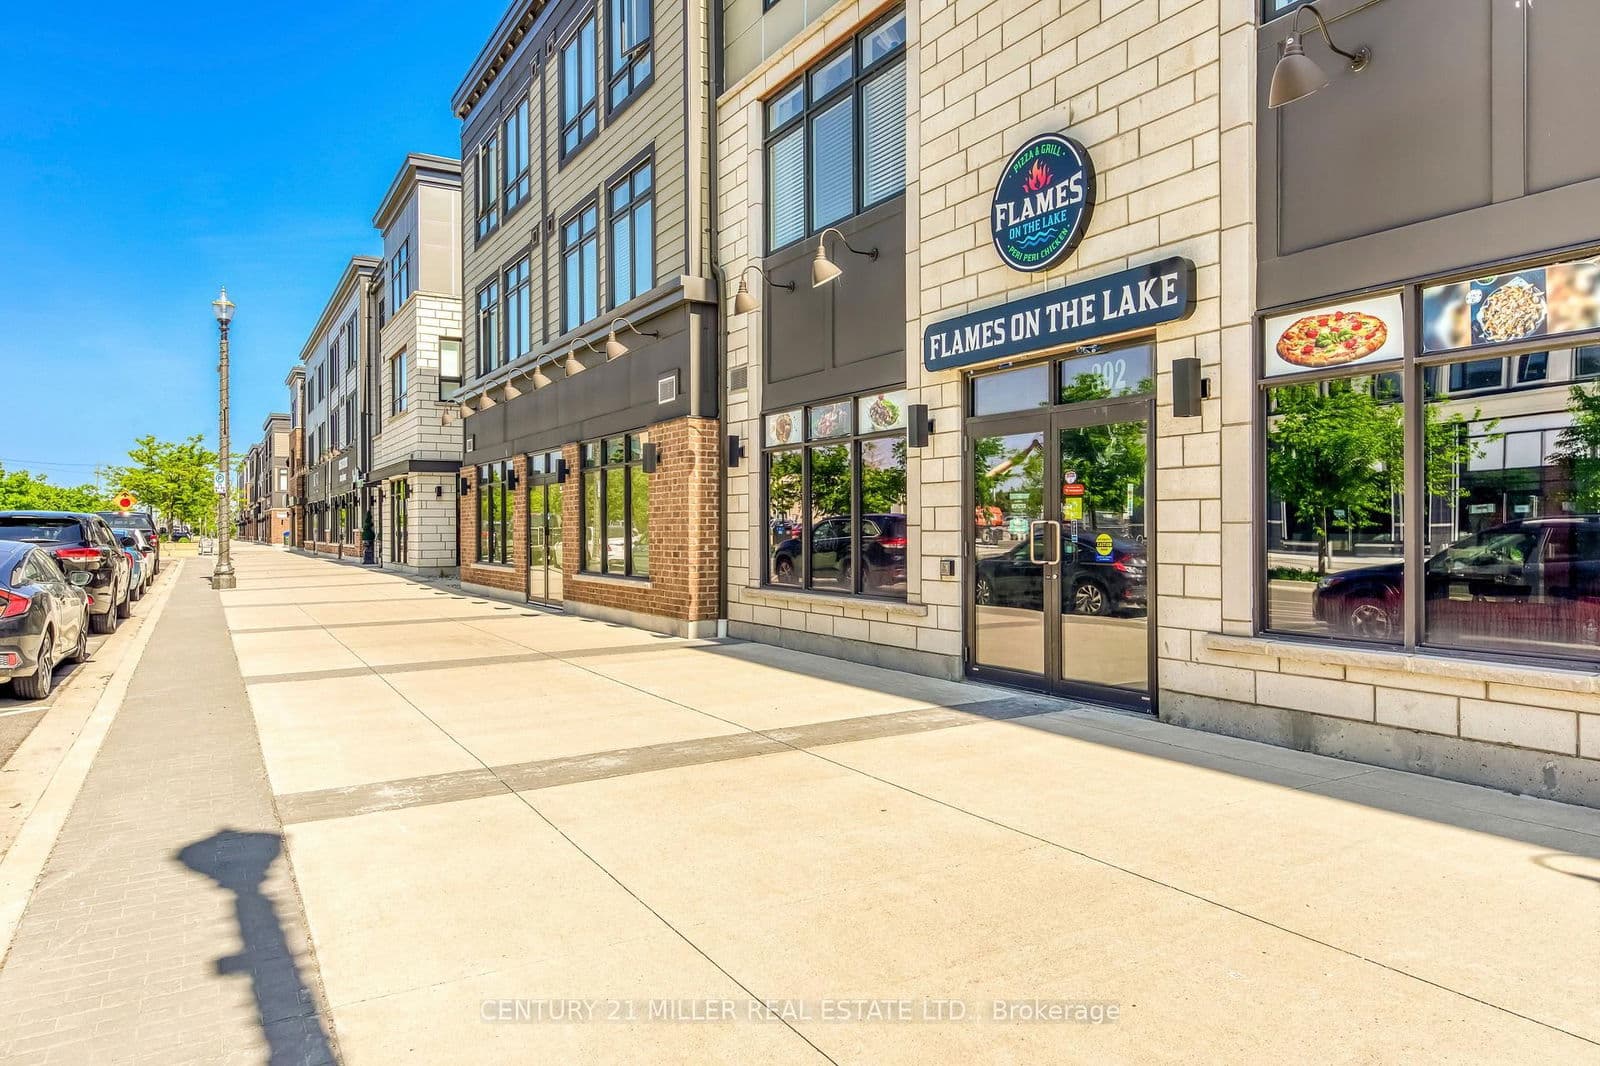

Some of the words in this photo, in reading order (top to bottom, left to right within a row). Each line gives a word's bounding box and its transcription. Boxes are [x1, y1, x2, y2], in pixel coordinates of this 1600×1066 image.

[1014, 150, 1034, 173] PIZZA
[1041, 144, 1061, 156] GRILL
[995, 170, 1083, 232] FLAMES
[1009, 225, 1021, 240] ON
[1023, 219, 1040, 235] THE
[1042, 209, 1067, 228] LAKE
[1008, 246, 1023, 260] PERI
[1023, 252, 1039, 262] PERI
[1040, 228, 1068, 258] CHICKEN
[929, 316, 1006, 360] FLAMES
[1010, 308, 1040, 342] ON
[1046, 294, 1096, 333] THE
[1102, 272, 1178, 321] LAKE
